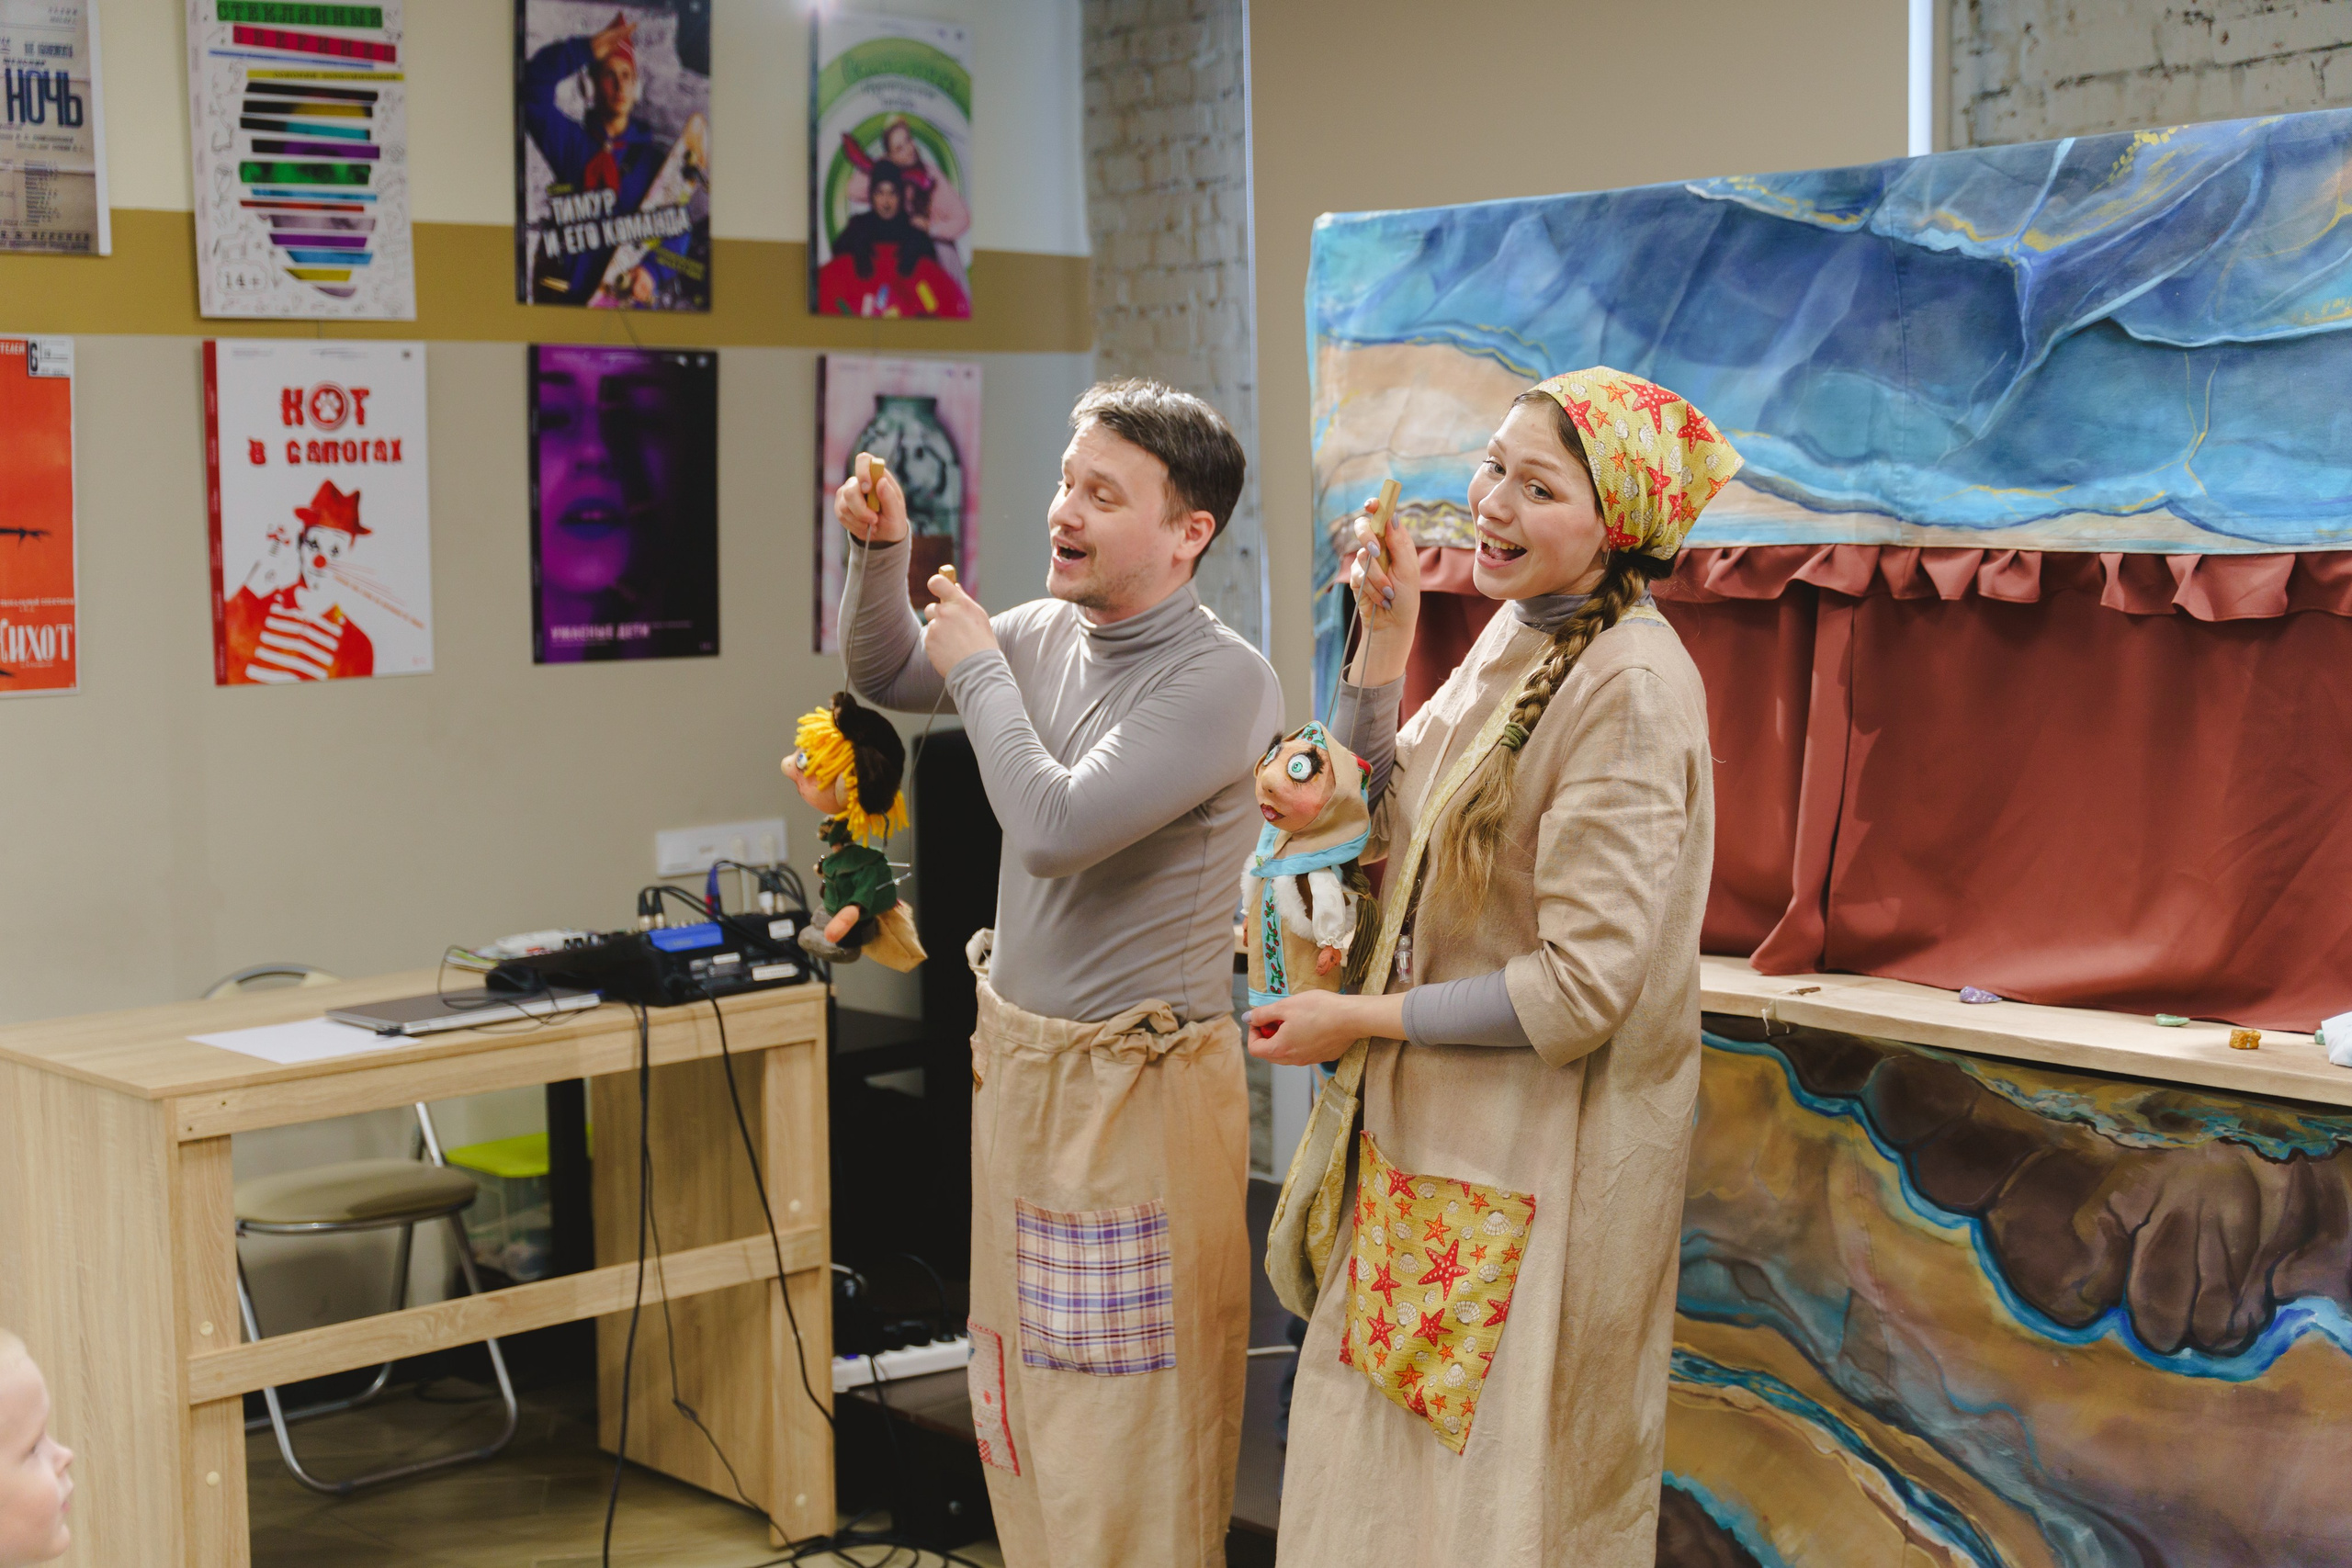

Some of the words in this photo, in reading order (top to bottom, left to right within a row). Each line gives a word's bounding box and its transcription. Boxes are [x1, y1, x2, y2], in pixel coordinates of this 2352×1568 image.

[5, 68, 83, 127] НОЧЬ
[550, 187, 616, 226] ТИМУР
[542, 229, 561, 259] И
[563, 222, 601, 255] ЕГО
[602, 207, 693, 248] КОМАНДА
[224, 272, 260, 288] 14+
